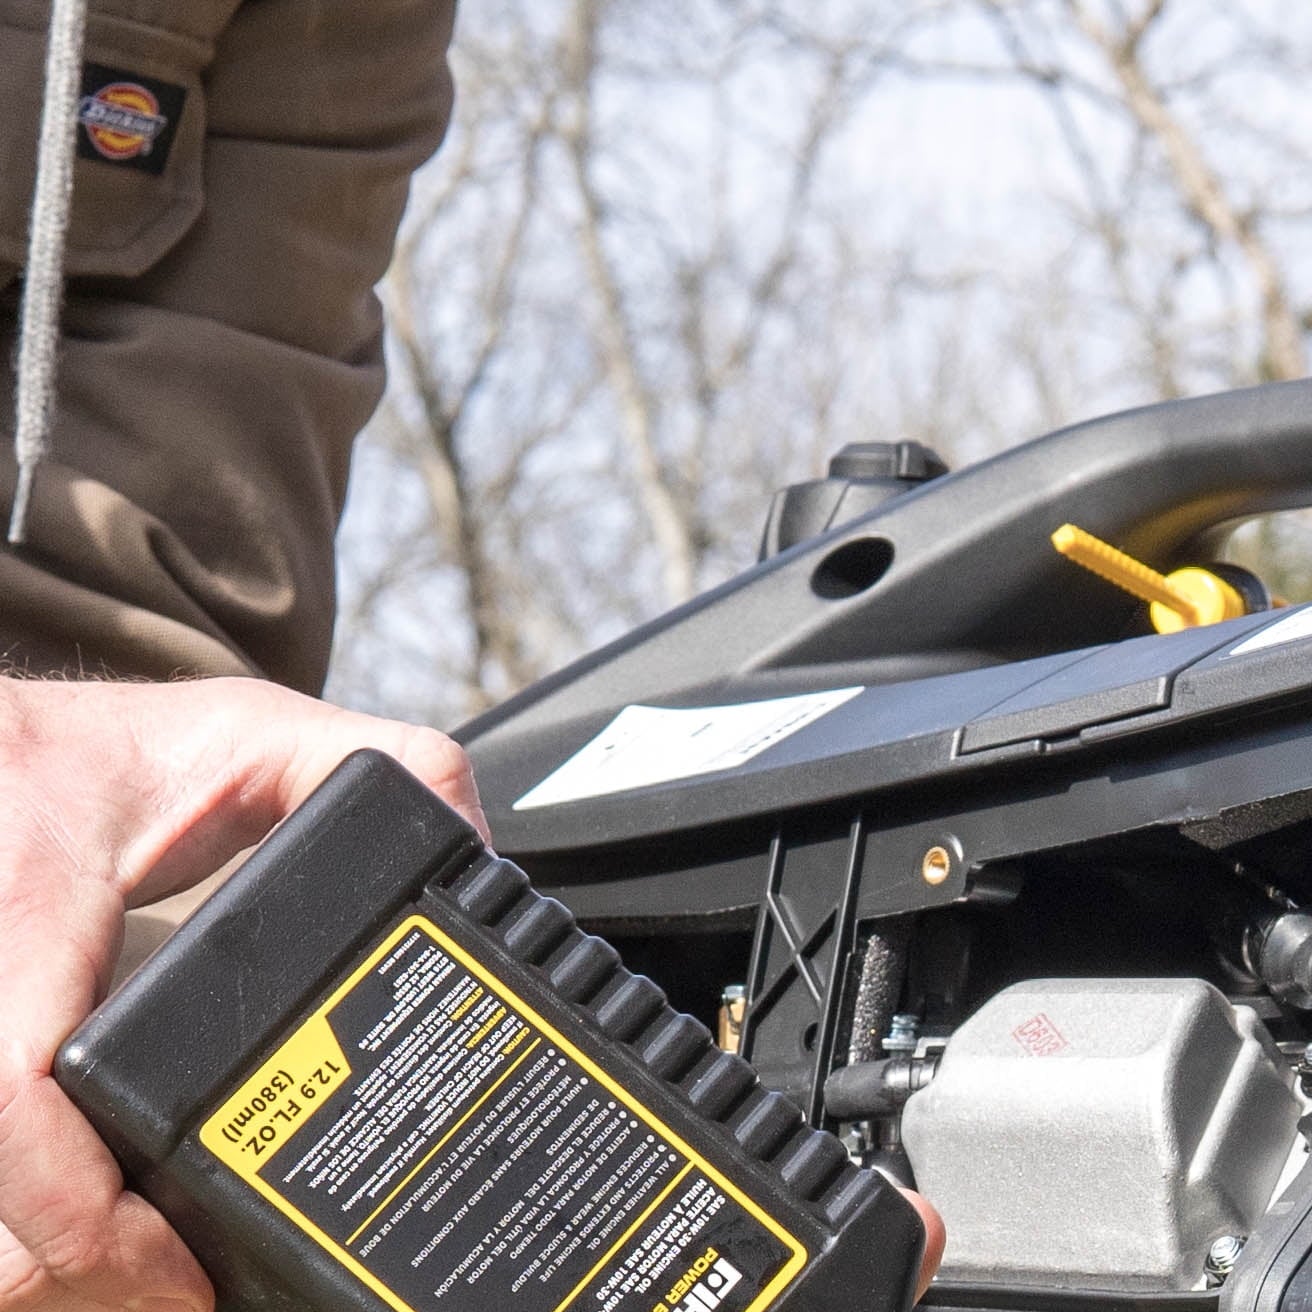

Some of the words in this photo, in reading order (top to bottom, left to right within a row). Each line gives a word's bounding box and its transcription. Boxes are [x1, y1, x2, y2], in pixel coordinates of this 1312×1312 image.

[416, 970, 436, 989] WEST
[410, 983, 435, 1007] POWER
[365, 1020, 386, 1041] SUITE
[379, 1004, 414, 1041] EQUIPMENT
[500, 1014, 517, 1032] KEEP
[487, 1029, 502, 1045] OUT
[460, 1050, 482, 1073] REACH
[466, 1064, 482, 1080] NOT
[478, 1053, 505, 1079] Contains
[522, 1054, 549, 1083] RÉDUIT
[299, 1060, 340, 1099] 12.9
[444, 1077, 469, 1102] INDUCE
[450, 1076, 481, 1108] petroleum
[526, 1064, 560, 1099] PROTÈGE
[221, 1069, 294, 1143] (380ml)
[494, 1080, 525, 1112] L'USURE
[518, 1096, 530, 1109] ET
[559, 1083, 582, 1107] HUILE
[586, 1098, 600, 1112] DE
[240, 1098, 302, 1156] FL.OZ.
[482, 1106, 521, 1146] PROLONGE
[484, 1109, 498, 1123] DU
[540, 1104, 562, 1127] POUR
[580, 1107, 610, 1138] REDUCE
[406, 1129, 419, 1144] call
[455, 1120, 487, 1153] MOTEUR
[509, 1124, 544, 1161] MOTEURS
[545, 1109, 589, 1156] SEDIMENTOS
[570, 1136, 583, 1146] EL
[587, 1116, 621, 1152] PROTEGE
[605, 1126, 631, 1154] ACEITE
[375, 1144, 404, 1175] physician
[401, 1135, 427, 1162] Harmful
[446, 1151, 459, 1164] ET
[472, 1144, 485, 1156] LA
[582, 1150, 591, 1158] Y
[594, 1151, 608, 1165] DE
[615, 1140, 648, 1176] REDUCES
[449, 1167, 463, 1182] DU
[459, 1155, 476, 1170] VIE
[490, 1158, 512, 1181] SANS
[537, 1145, 574, 1185] DESGASTE
[545, 1155, 585, 1195] PROLONGA
[623, 1150, 659, 1189] PROTECTS
[654, 1159, 669, 1175] ALL
[571, 1162, 598, 1190] MOTOR
[590, 1173, 618, 1203] ENGINE
[388, 1161, 449, 1225] L'ACCUMULATION
[420, 1179, 453, 1212] MOTEUR
[467, 1178, 494, 1206] ÉGARD
[523, 1182, 541, 1198] DEL
[536, 1194, 549, 1206] LA
[552, 1188, 575, 1210] PARA
[609, 1186, 625, 1205] AND
[622, 1175, 658, 1211] WEATHER
[679, 1177, 707, 1207] HUILE
[685, 1185, 716, 1220] ACEITE
[451, 1203, 469, 1223] AUX
[497, 1199, 525, 1227] MOTOR
[519, 1205, 540, 1224] VIDA
[569, 1201, 594, 1225] WEAR
[672, 1203, 685, 1215] À
[705, 1194, 726, 1216] SAE
[378, 1222, 392, 1236] DE
[492, 1226, 501, 1235] Y
[503, 1223, 523, 1241] ÚTIL
[534, 1209, 556, 1231] TODO
[564, 1223, 573, 1231] &
[578, 1203, 611, 1238] EXTENDS
[597, 1208, 626, 1239] ENGINE
[640, 1211, 677, 1250] MOTEUR
[663, 1216, 690, 1243] PARA
[677, 1213, 710, 1247] 10W-30
[358, 1233, 382, 1257] BOUE
[410, 1221, 454, 1268] CONDITIONS
[481, 1231, 495, 1244] LA
[490, 1240, 507, 1256] DEL
[508, 1230, 538, 1259] TIEMPO
[537, 1229, 567, 1261] SLUDGE
[585, 1236, 601, 1250] OIL
[553, 1236, 582, 1266] ENGINE
[623, 1247, 644, 1269] SAE
[635, 1240, 668, 1274] MOTOR
[647, 1244, 681, 1280] ENGINE
[465, 1255, 493, 1284] MOTOR
[510, 1258, 541, 1293] BUILDUP
[538, 1264, 556, 1282] LIFE
[619, 1271, 640, 1293] SAE
[664, 1246, 718, 1304] POWER
[595, 1266, 628, 1300] 10W-30
[633, 1277, 651, 1294] OIL
